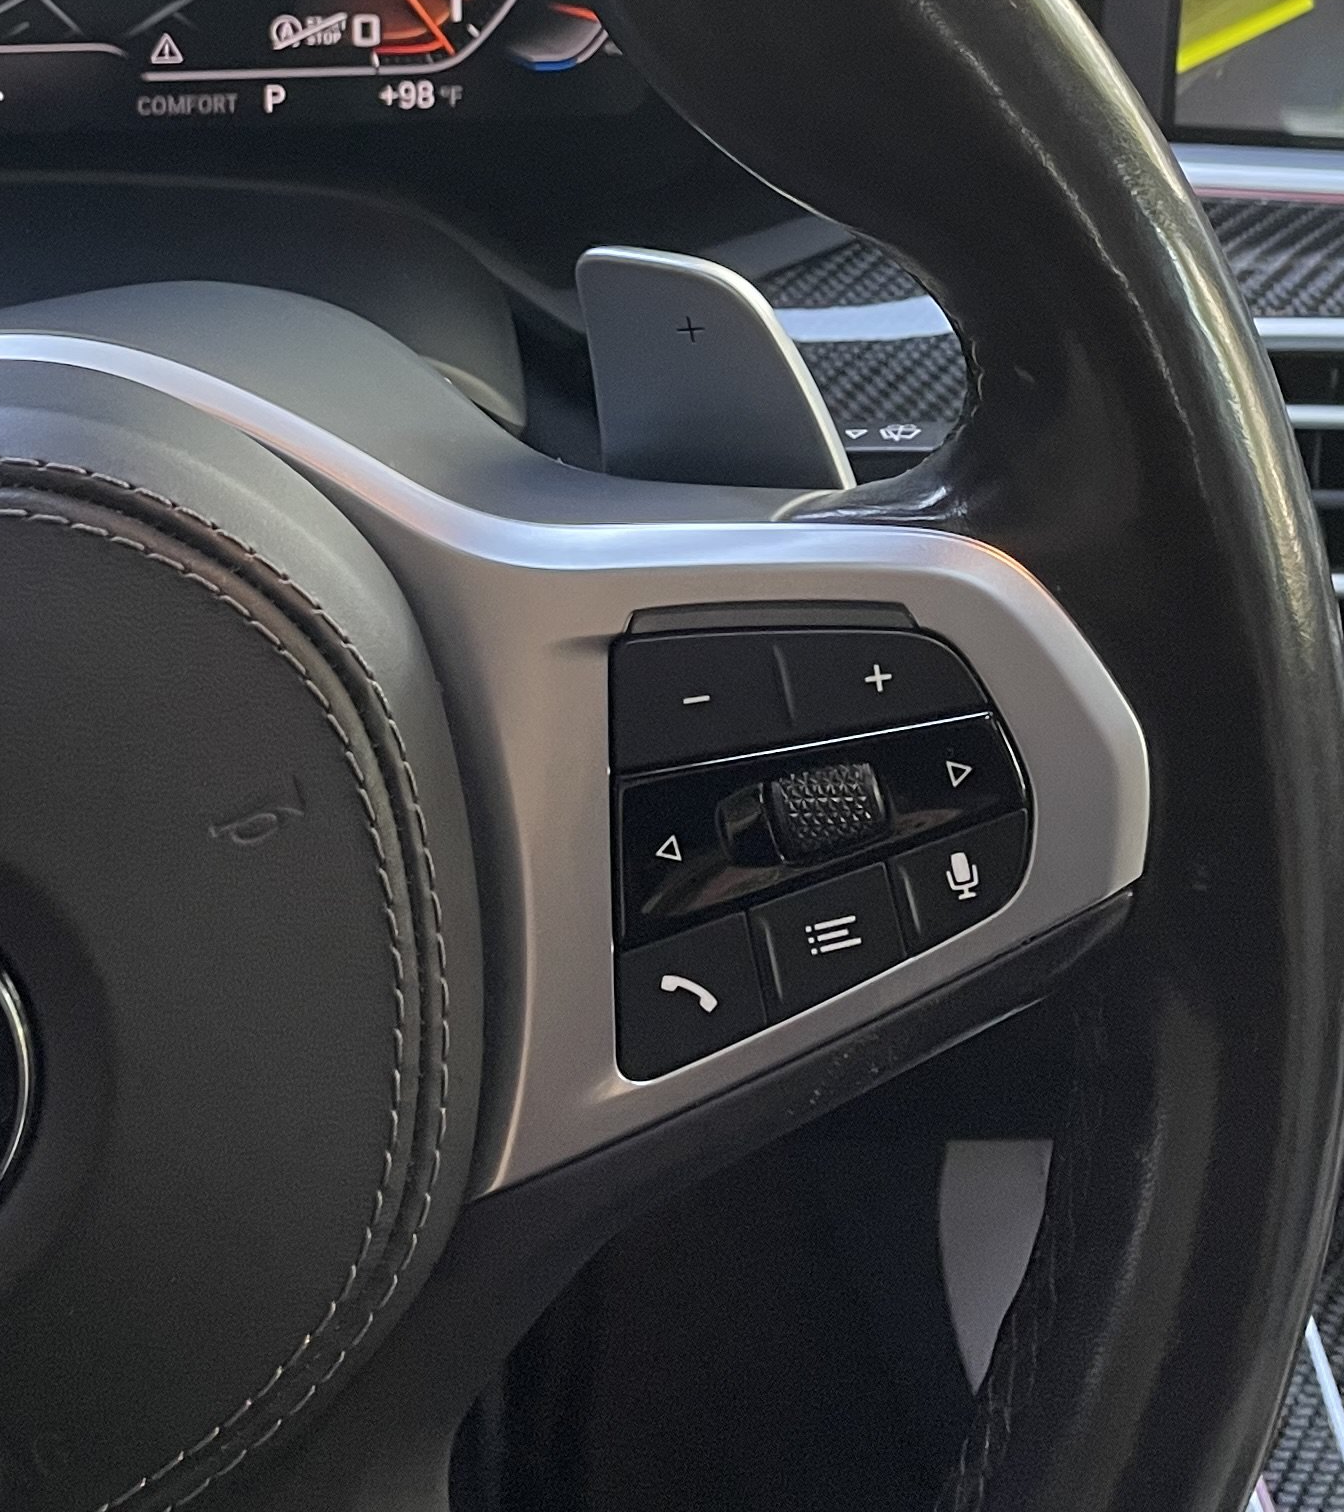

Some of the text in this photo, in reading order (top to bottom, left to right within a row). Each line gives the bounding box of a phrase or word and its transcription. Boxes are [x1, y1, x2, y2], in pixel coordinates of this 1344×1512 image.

[353, 14, 381, 47] 0
[137, 92, 239, 116] COMFORT
[264, 84, 287, 114] P
[378, 80, 437, 109] +98
